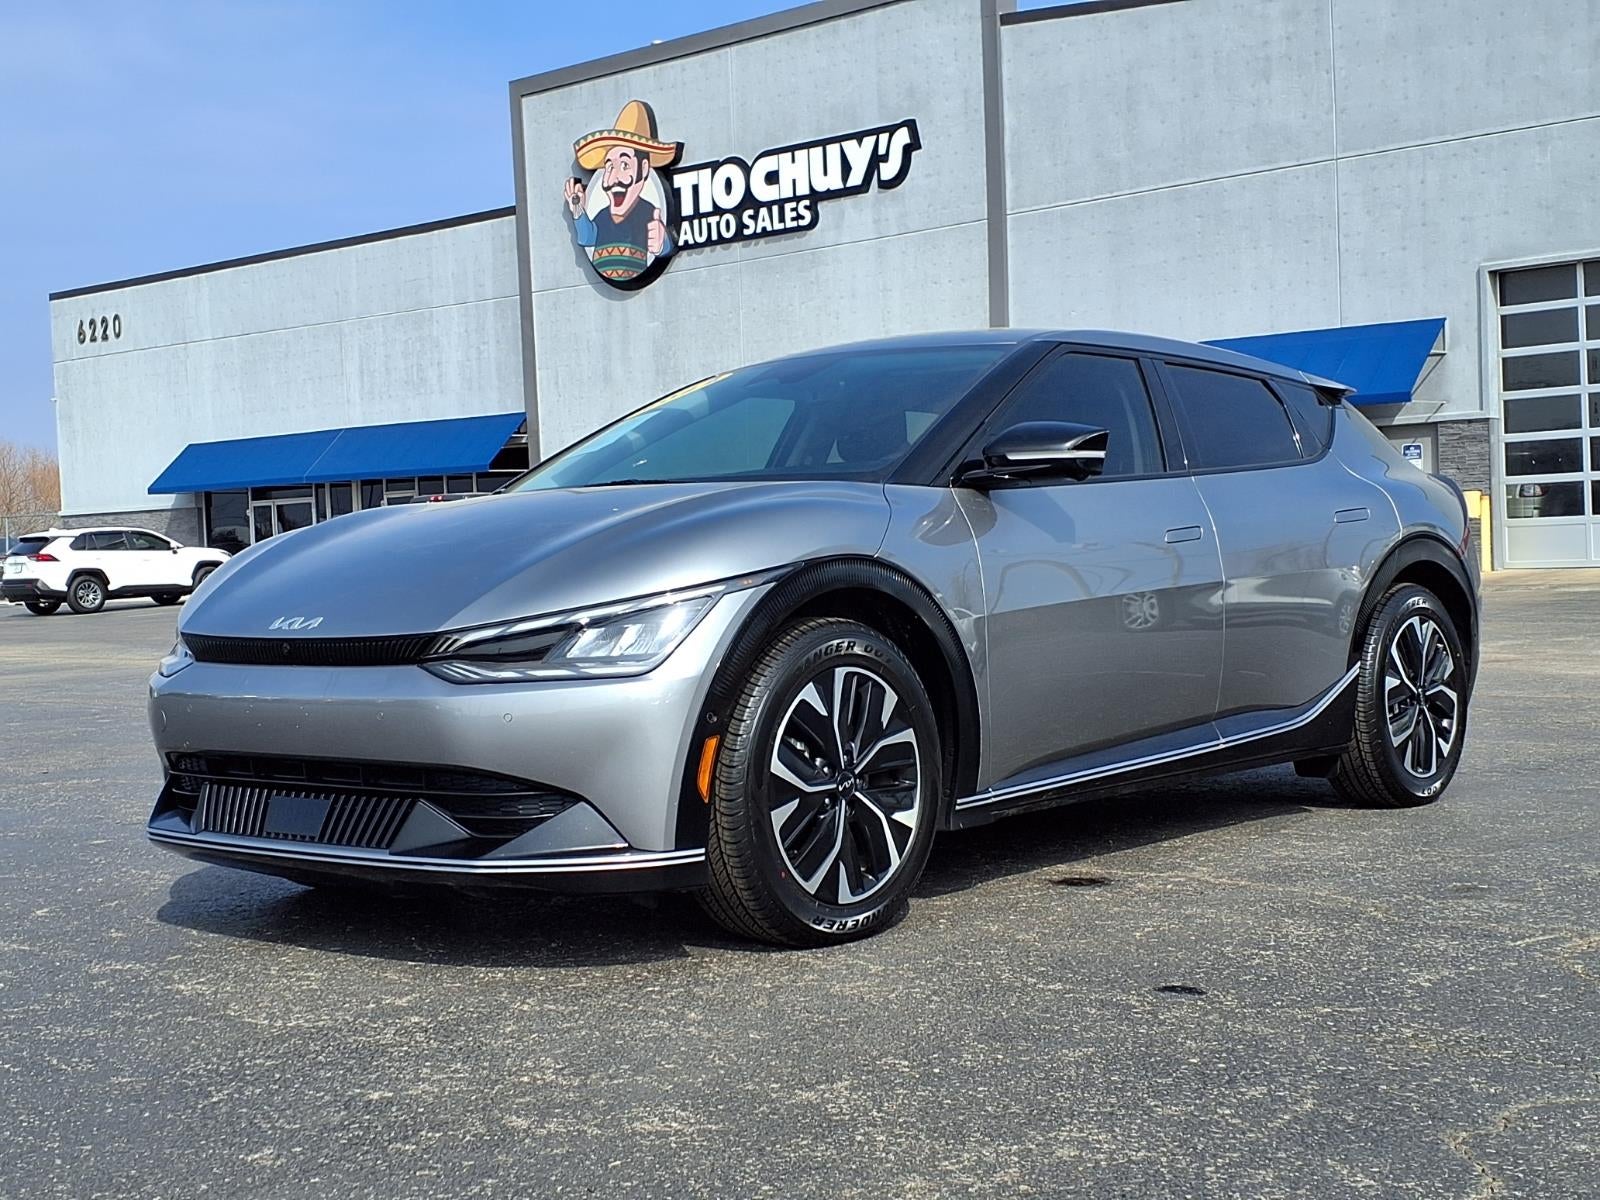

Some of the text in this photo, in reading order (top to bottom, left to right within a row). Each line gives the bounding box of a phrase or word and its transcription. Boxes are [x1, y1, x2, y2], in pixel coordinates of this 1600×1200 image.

[673, 126, 911, 217] TIO CHUY'S
[678, 200, 812, 246] AUTO SALES
[77, 313, 122, 345] 6220
